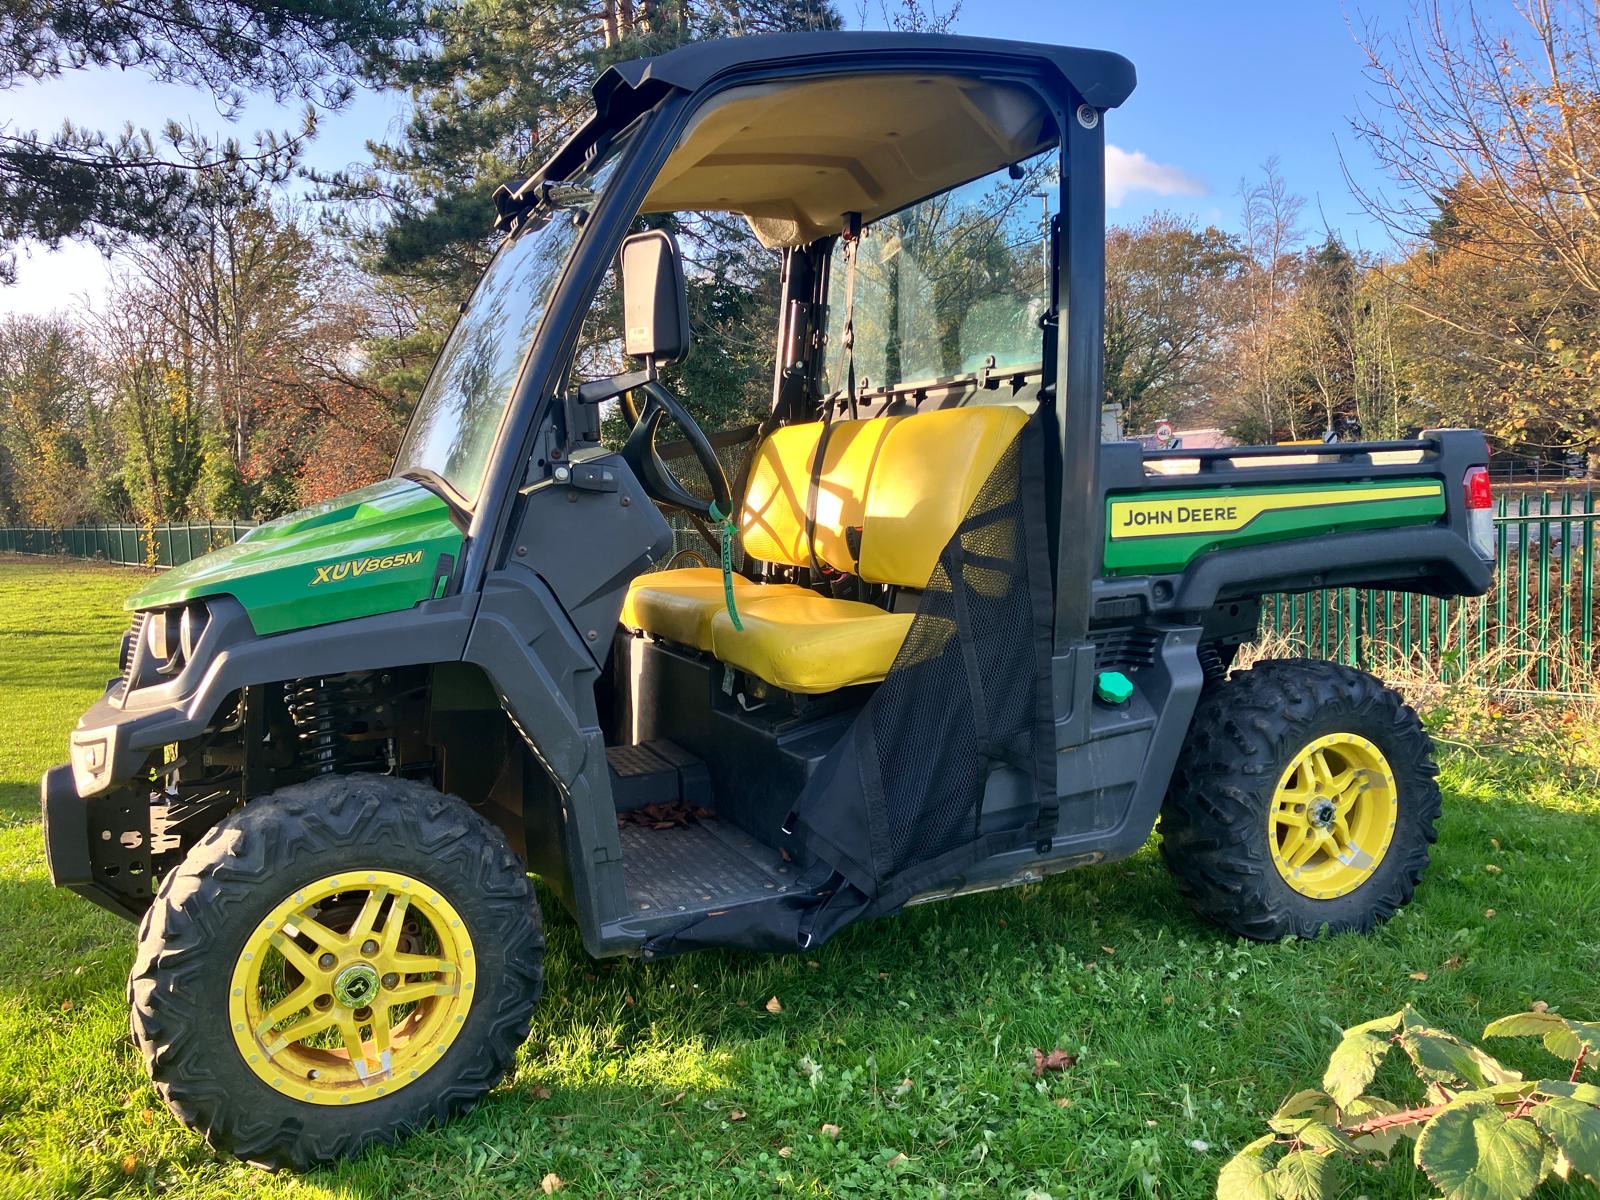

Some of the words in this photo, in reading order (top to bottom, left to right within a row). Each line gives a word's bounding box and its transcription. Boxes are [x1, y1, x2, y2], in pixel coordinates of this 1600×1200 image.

[1123, 509, 1173, 527] JOHN
[1177, 506, 1238, 524] DEERE
[309, 550, 424, 586] XUV865M
